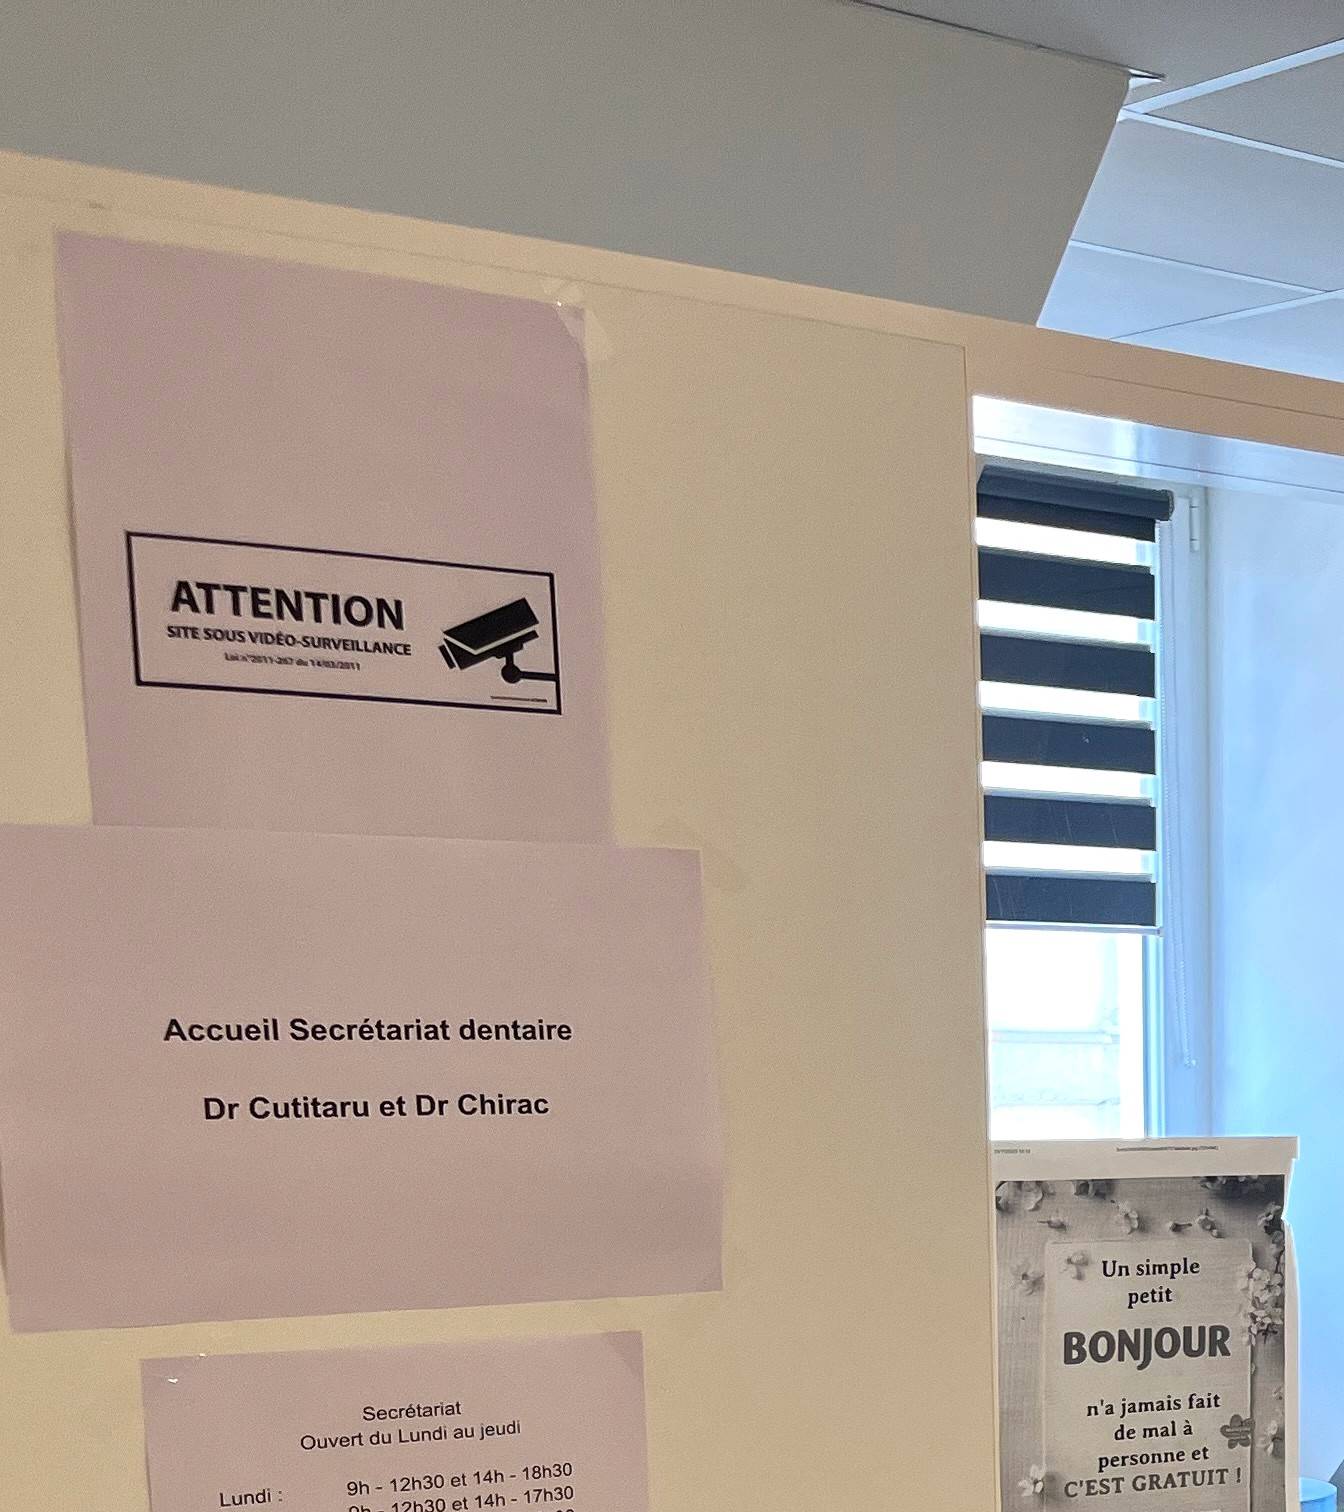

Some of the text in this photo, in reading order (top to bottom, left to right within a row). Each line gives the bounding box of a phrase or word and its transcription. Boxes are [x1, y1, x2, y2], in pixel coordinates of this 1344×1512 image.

[170, 581, 403, 629] ATTENTION
[167, 626, 411, 655] SITE SOUS VIDÉO-SURVEILLANCE
[164, 1018, 571, 1041] Accueil Secrétariat dentaire
[204, 1094, 548, 1119] Dr Cutitaru et Dr Chirac
[1102, 1257, 1199, 1279] Un simple
[1128, 1286, 1172, 1309] petit
[1064, 1325, 1230, 1370] BONJOUR
[363, 1402, 461, 1421] Secrétariat
[1087, 1393, 1220, 1418] n'a jamais fait
[301, 1421, 520, 1450] Ouvert du Lundi au jeudi
[1115, 1420, 1192, 1440] de mal à
[1098, 1447, 1209, 1473] personne et
[220, 1488, 271, 1507] Lundi
[347, 1481, 369, 1496] 9h
[390, 1475, 444, 1492] 12h30
[451, 1474, 467, 1487] et
[473, 1470, 504, 1484] 14h
[523, 1463, 572, 1480] 18h30
[1064, 1467, 1241, 1498] C'EST GRATUIT !
[452, 1497, 468, 1511] et
[475, 1494, 505, 1508] 14h
[524, 1486, 573, 1503] 17h30
